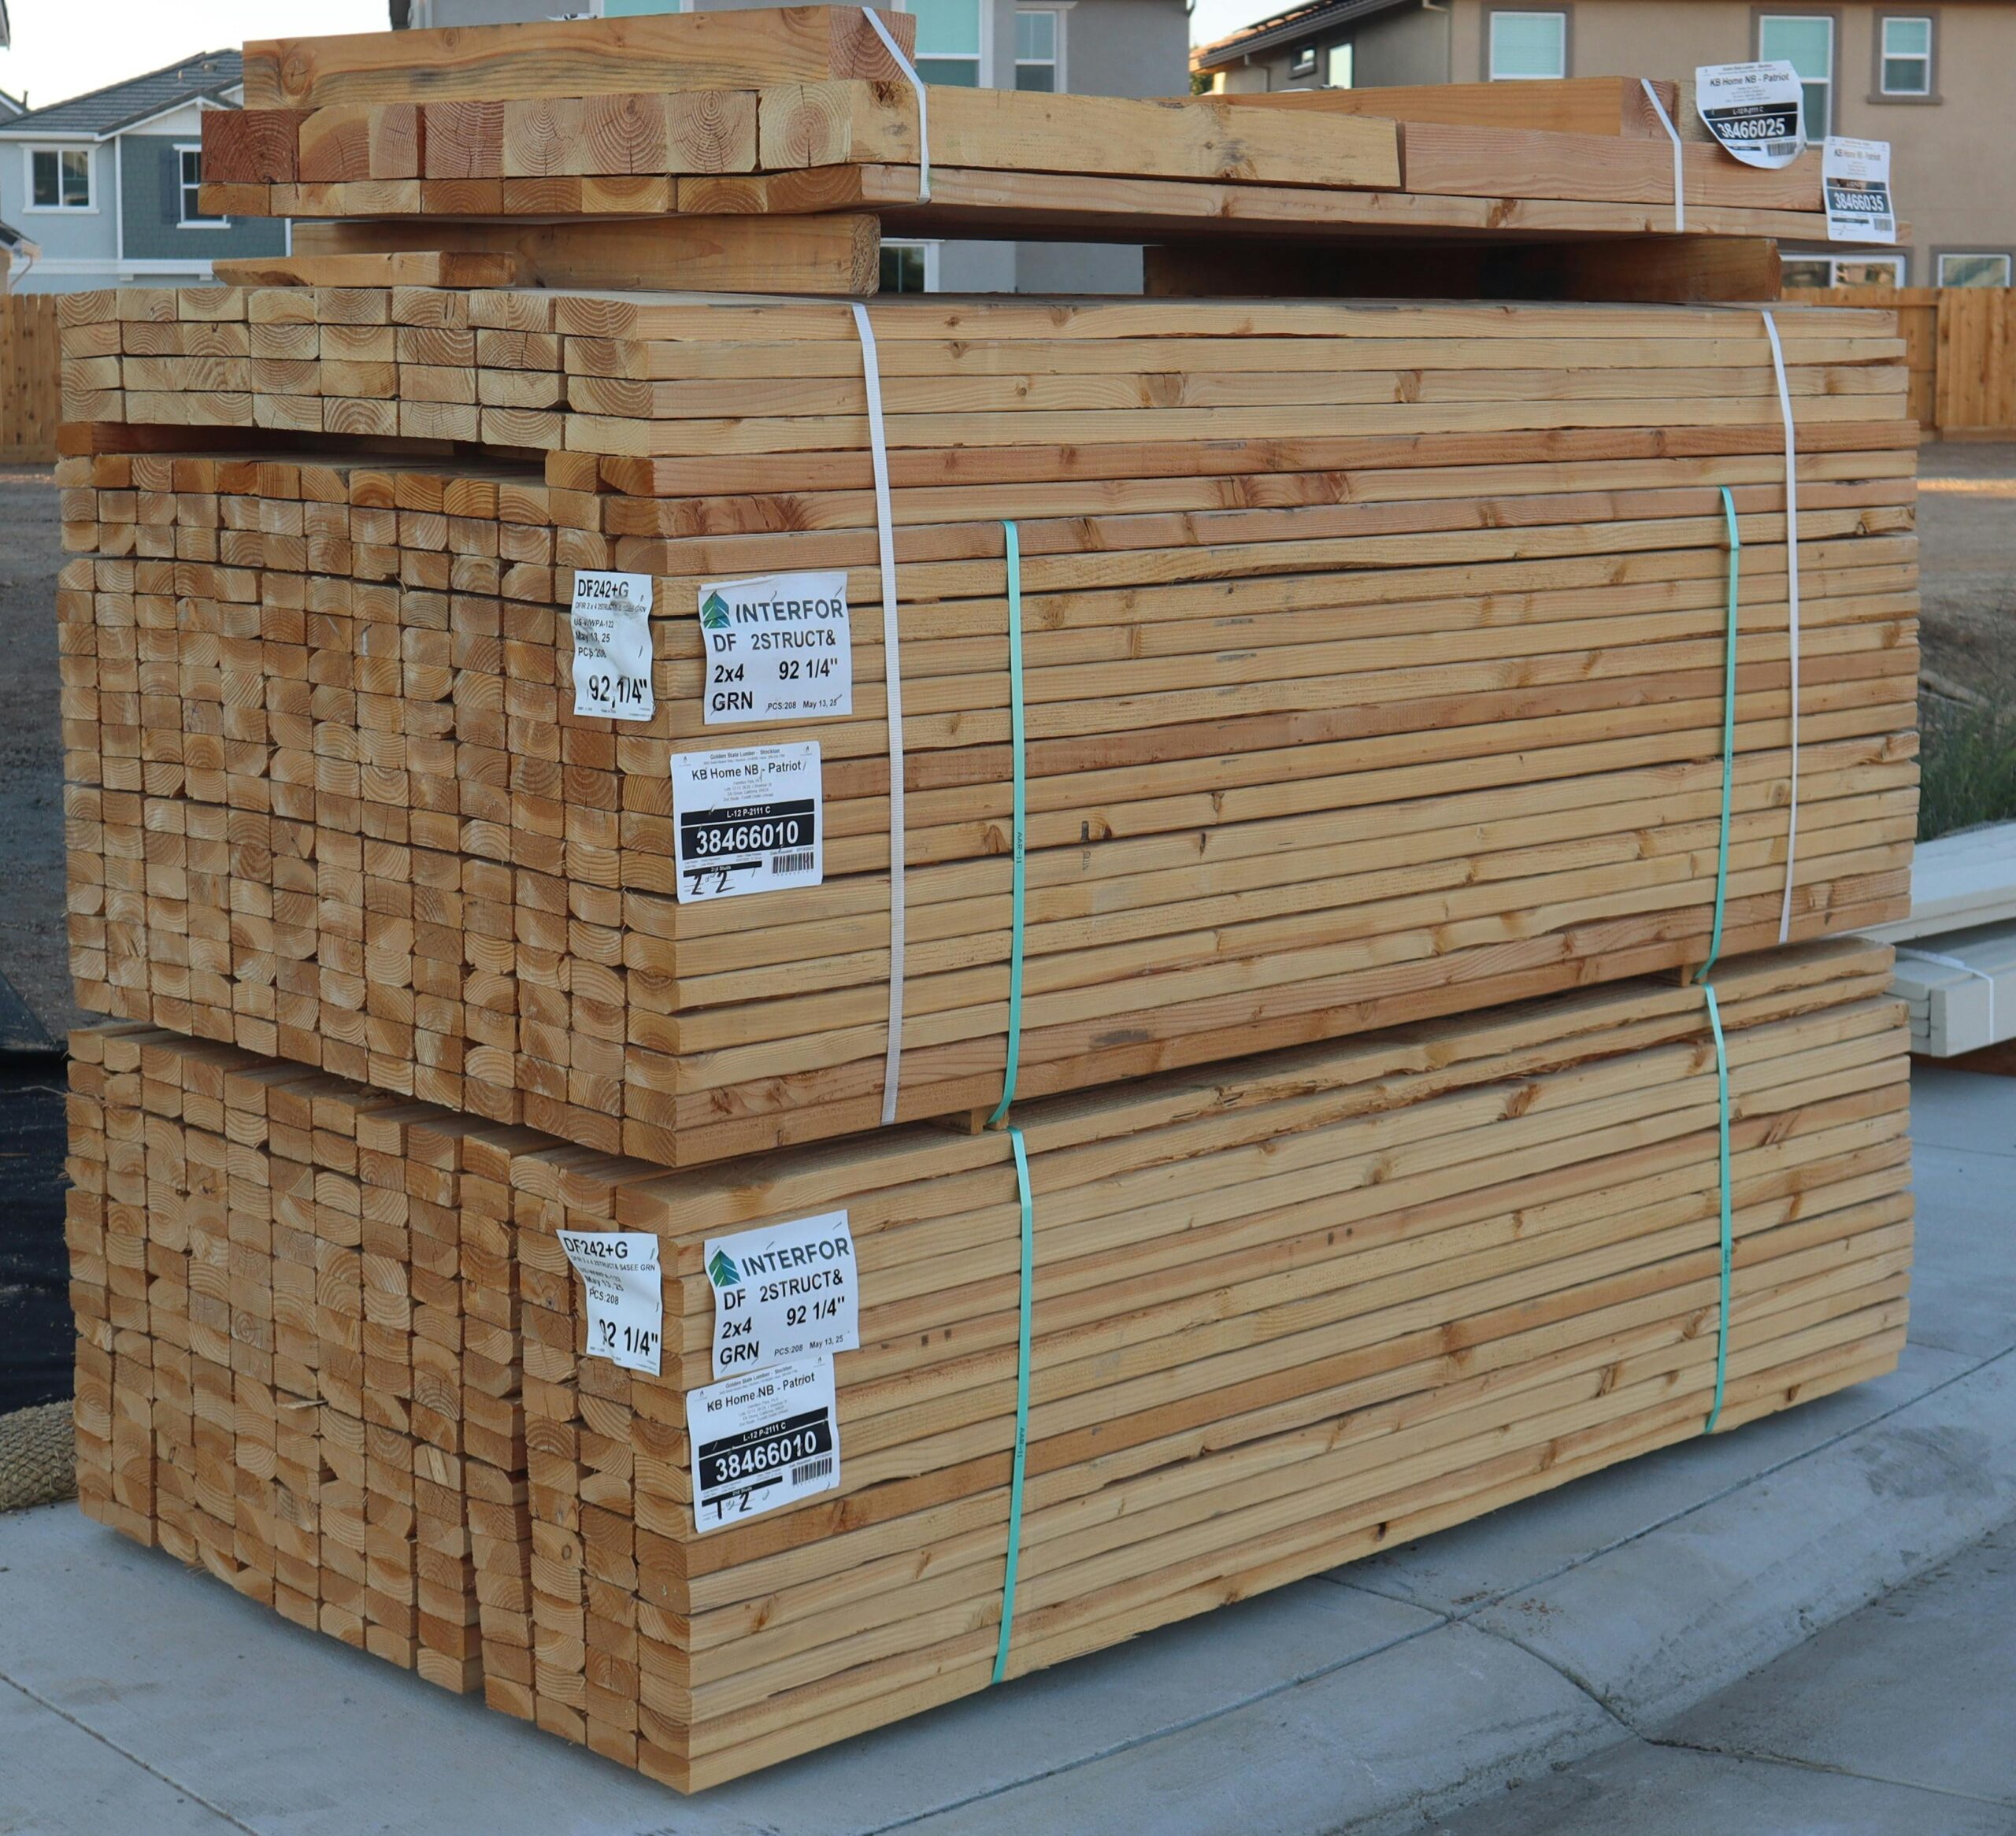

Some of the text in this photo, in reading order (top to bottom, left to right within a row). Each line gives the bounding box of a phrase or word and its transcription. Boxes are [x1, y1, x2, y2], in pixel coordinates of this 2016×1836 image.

[1722, 76, 1743, 85] Home
[1763, 73, 1789, 83] Patriot
[1717, 118, 1786, 139] 38466025
[1834, 192, 1884, 212] 38466035
[578, 579, 628, 598] DF242+G
[736, 598, 844, 624] INTERFOR
[576, 631, 588, 642] May
[602, 632, 610, 642] 25
[713, 629, 836, 652] DF 2STRUCT&
[713, 657, 838, 683] 2x4 92 1/4"
[589, 674, 610, 701] 92
[712, 690, 753, 712] GRN
[768, 701, 796, 710] PCS:208
[803, 700, 816, 709] May
[691, 768, 707, 781] KB
[710, 767, 742, 779] Home
[744, 764, 758, 775] NB
[768, 760, 802, 774] Patriot
[727, 808, 741, 818] L-12
[743, 806, 763, 816] P-2111
[696, 820, 799, 855] 38466010
[715, 871, 736, 894] 2
[563, 1237, 628, 1259] DF242+G
[741, 1237, 850, 1277] INTERFOR
[589, 1288, 619, 1305] PCS:208
[724, 1268, 843, 1310] DF 2STRUCT&
[721, 1296, 845, 1340] 2x4 92 1/4"
[624, 1326, 658, 1357] 1/4"
[720, 1341, 760, 1366] GRN
[774, 1344, 803, 1357] PCS:208
[810, 1341, 823, 1349] May
[836, 1334, 843, 1343] 25
[707, 1399, 722, 1412] KB
[725, 1391, 755, 1408] Home
[758, 1384, 774, 1397] NB
[783, 1372, 815, 1390] Patriot
[743, 1431, 758, 1442] L-12
[758, 1424, 780, 1438] P-2111
[716, 1431, 817, 1482] 38466010
[739, 1492, 753, 1512] 2
